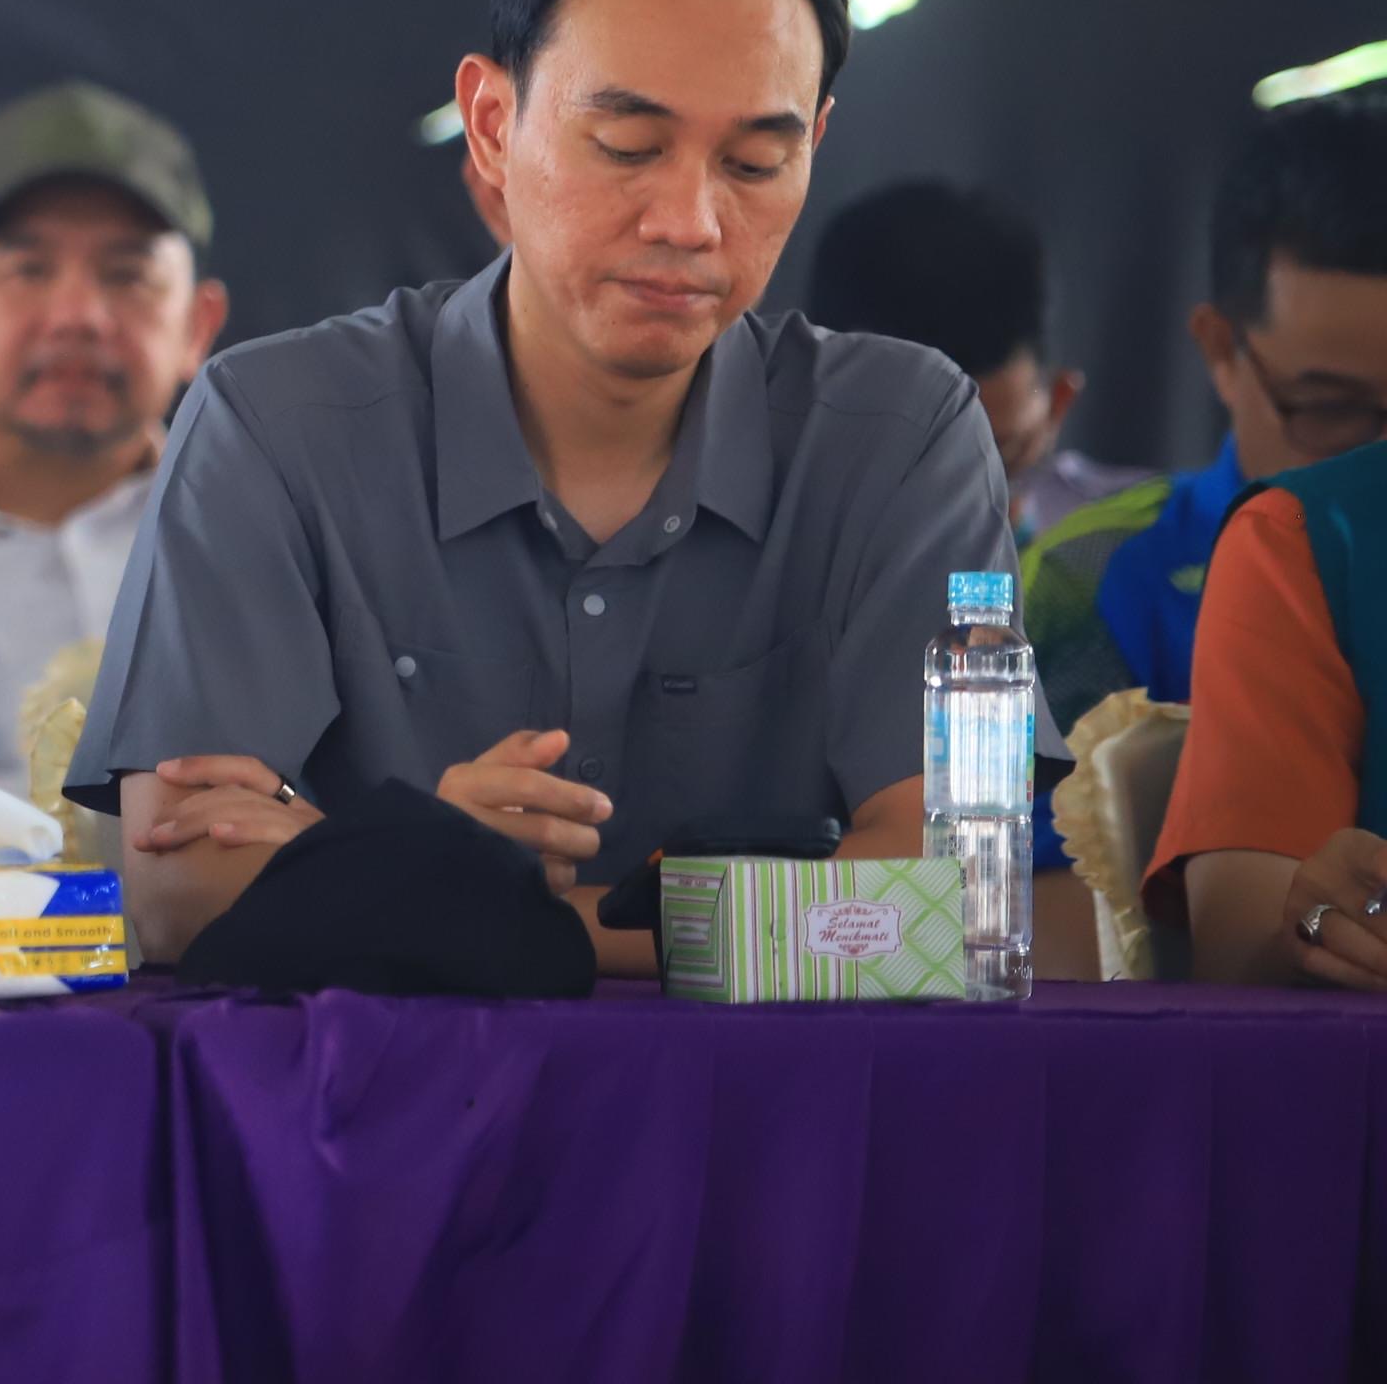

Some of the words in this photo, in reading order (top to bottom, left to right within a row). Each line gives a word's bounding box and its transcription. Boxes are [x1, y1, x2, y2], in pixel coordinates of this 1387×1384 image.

[828, 917, 880, 929] Selamat
[23, 927, 51, 938] and
[56, 926, 112, 938] Smooth
